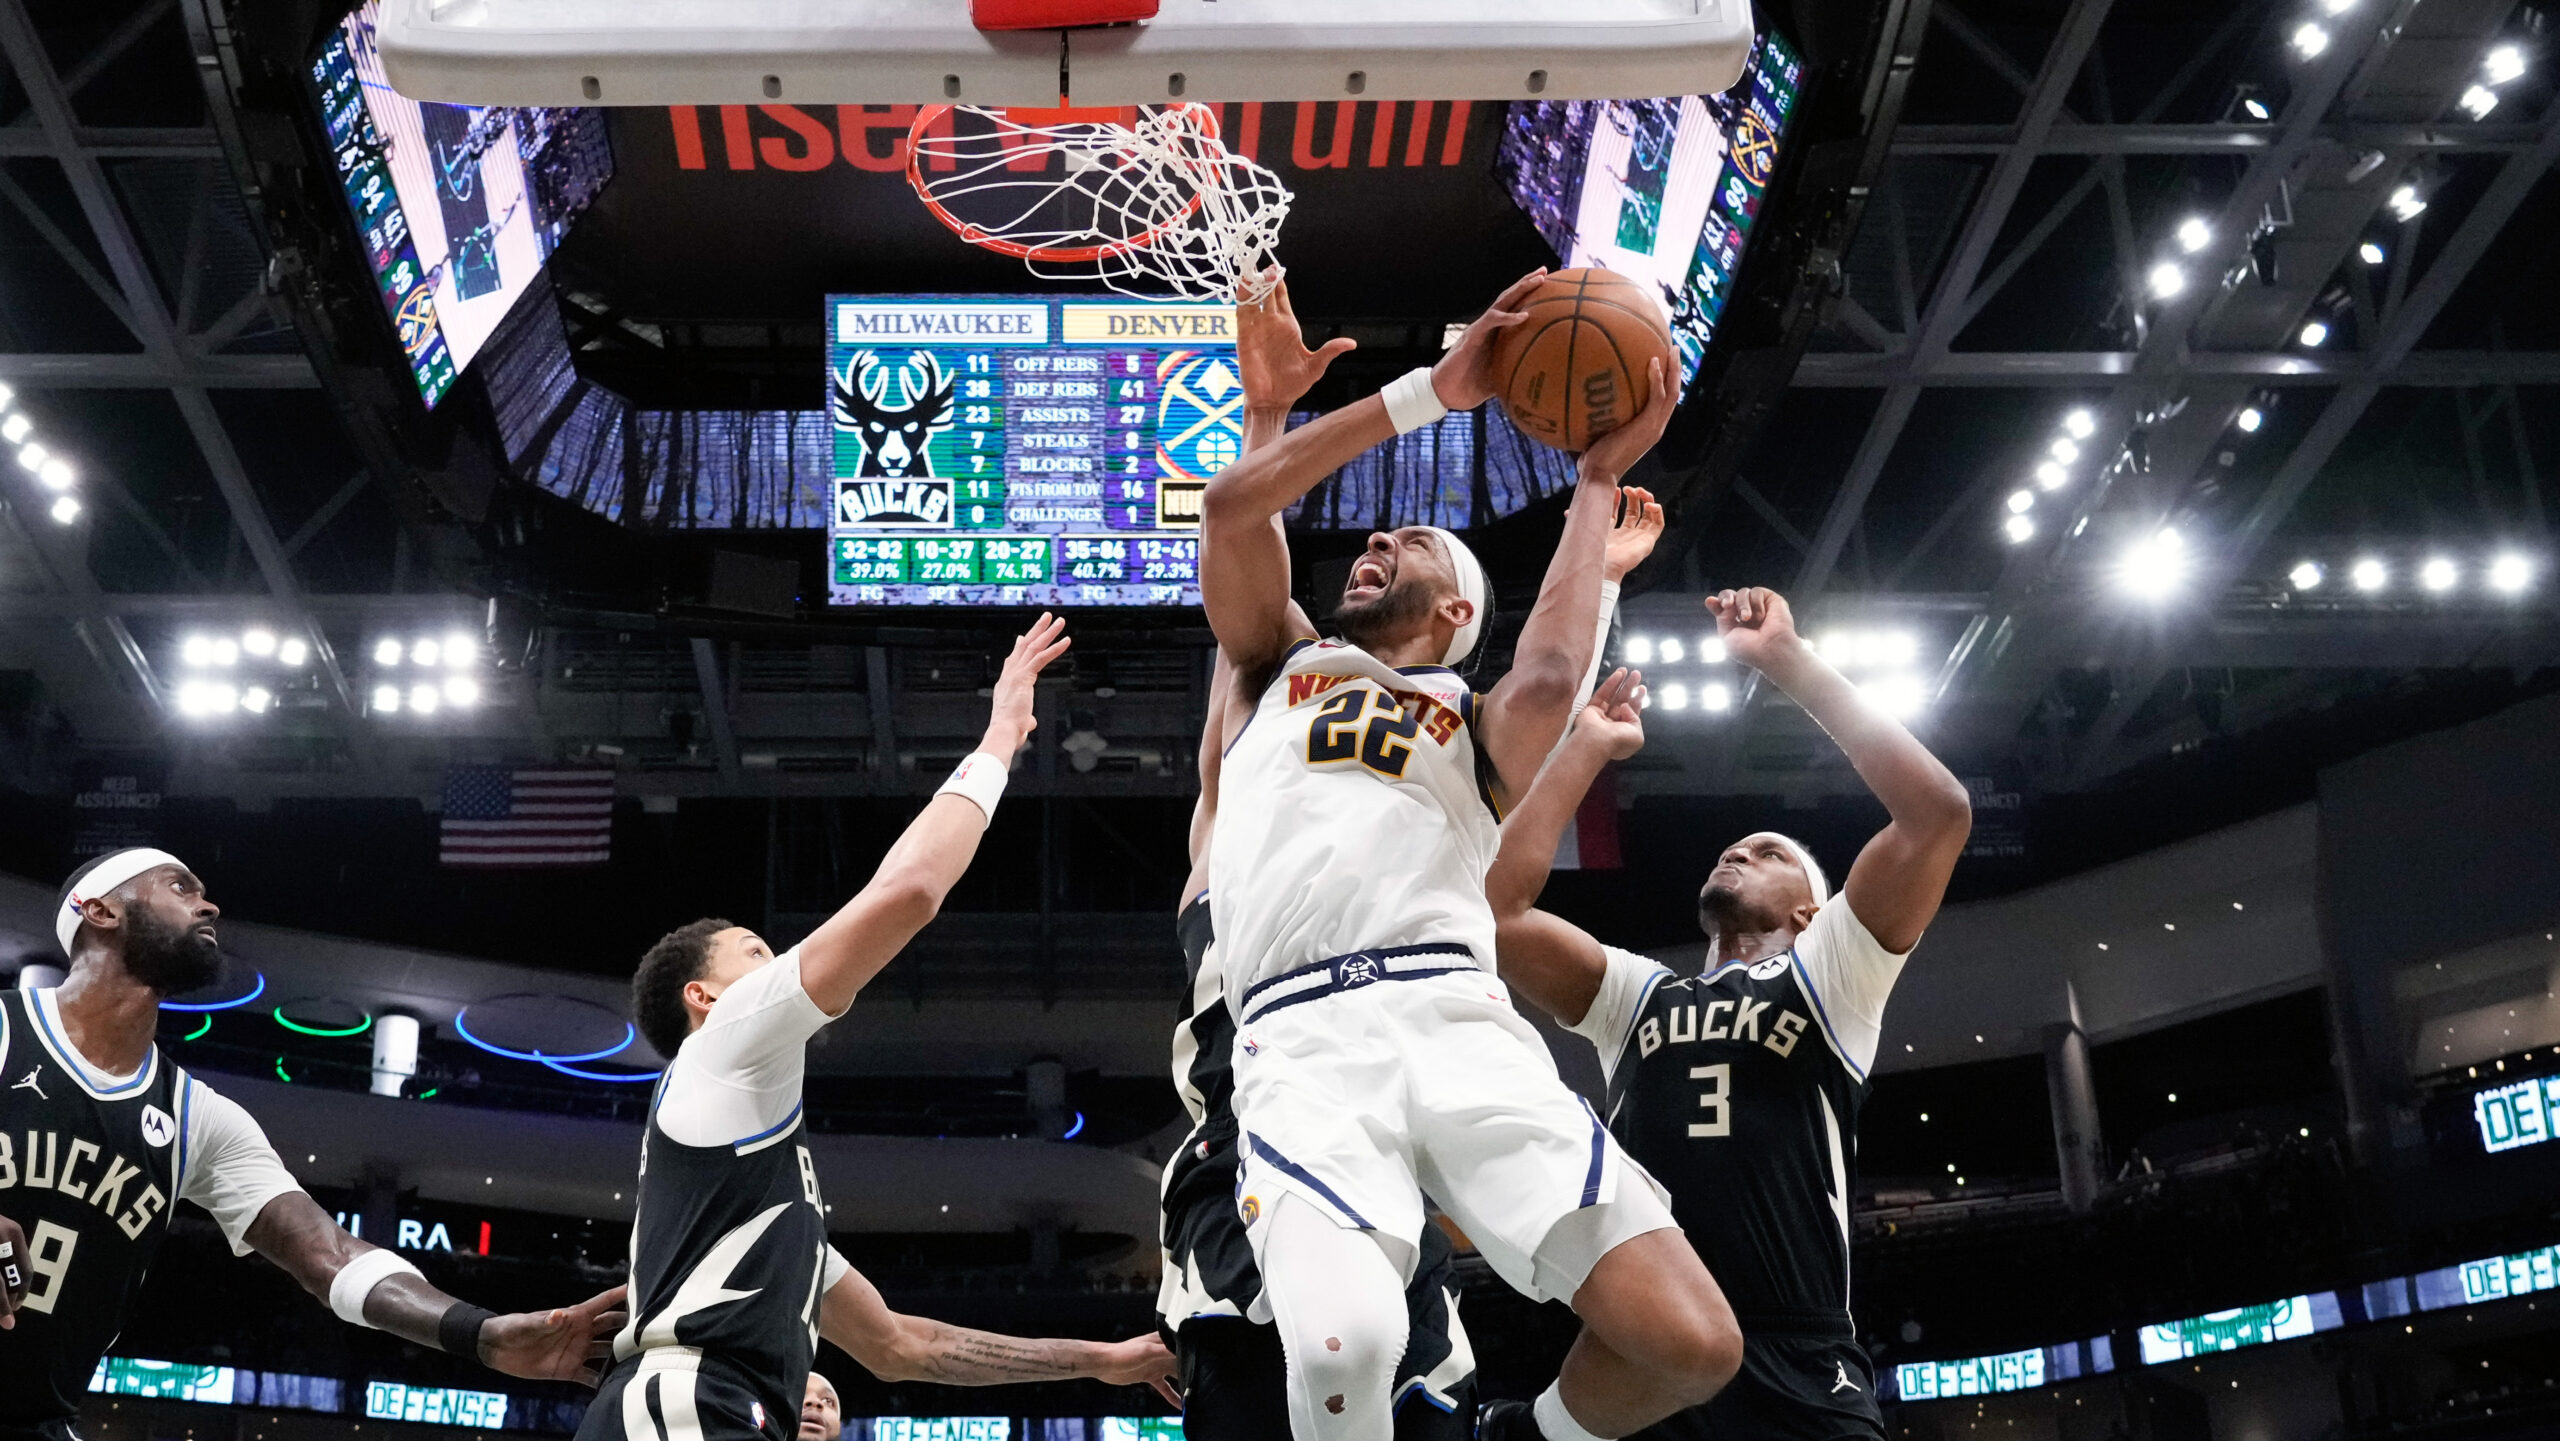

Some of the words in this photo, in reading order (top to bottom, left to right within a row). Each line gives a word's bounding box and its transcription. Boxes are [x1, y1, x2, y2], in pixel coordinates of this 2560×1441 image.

[361, 175, 385, 214] 94
[1725, 176, 1748, 215] 99
[391, 261, 413, 295] 99
[1696, 261, 1719, 299] 94
[855, 314, 1032, 334] MILWAUKEE
[1108, 315, 1229, 335] DENVER
[966, 355, 990, 373] 11
[1014, 356, 1050, 371] OFF
[1053, 356, 1098, 372] REBS
[1126, 355, 1140, 373] 5
[965, 380, 990, 398] 38
[1014, 382, 1050, 397] DEF
[1053, 382, 1098, 397] REBS
[1120, 380, 1144, 398] 41
[965, 406, 990, 423] 23
[1021, 407, 1090, 422] ASSISTS
[1120, 406, 1145, 423] 27
[971, 431, 984, 449] 7
[1022, 433, 1089, 448] STEALS
[1125, 432, 1139, 449] 8
[971, 455, 985, 473] 7
[1019, 457, 1093, 472] BLOCKS
[1125, 456, 1139, 473] 2
[967, 480, 989, 498] 11
[1010, 483, 1036, 497] PTS
[1037, 483, 1075, 497] FROM
[1121, 481, 1145, 498] 16
[841, 483, 948, 523] BUCKS
[1010, 507, 1101, 522] CHALLENGES
[1127, 506, 1137, 523] 1
[842, 541, 902, 560] 32-82
[915, 541, 974, 560] 10-37
[985, 541, 1046, 560] 20-27
[1065, 541, 1126, 560] 35-86
[1138, 541, 1196, 560] 12-41
[850, 563, 899, 579] 39.0%
[921, 563, 971, 579] 27.0%
[996, 563, 1042, 579] 74.1%
[1072, 563, 1123, 579] 40.7%
[1143, 563, 1194, 579] 29.3%
[860, 585, 884, 600] FG
[927, 585, 960, 600] 3PT
[1003, 585, 1027, 600] FT
[1082, 585, 1106, 600] FG
[1149, 585, 1182, 600] 3PT
[1306, 688, 1421, 779] 22
[1638, 996, 1808, 1058] BUCKS
[1688, 1063, 1730, 1137] 3
[5, 1264, 21, 1287] 9
[20, 1219, 79, 1314] 9
